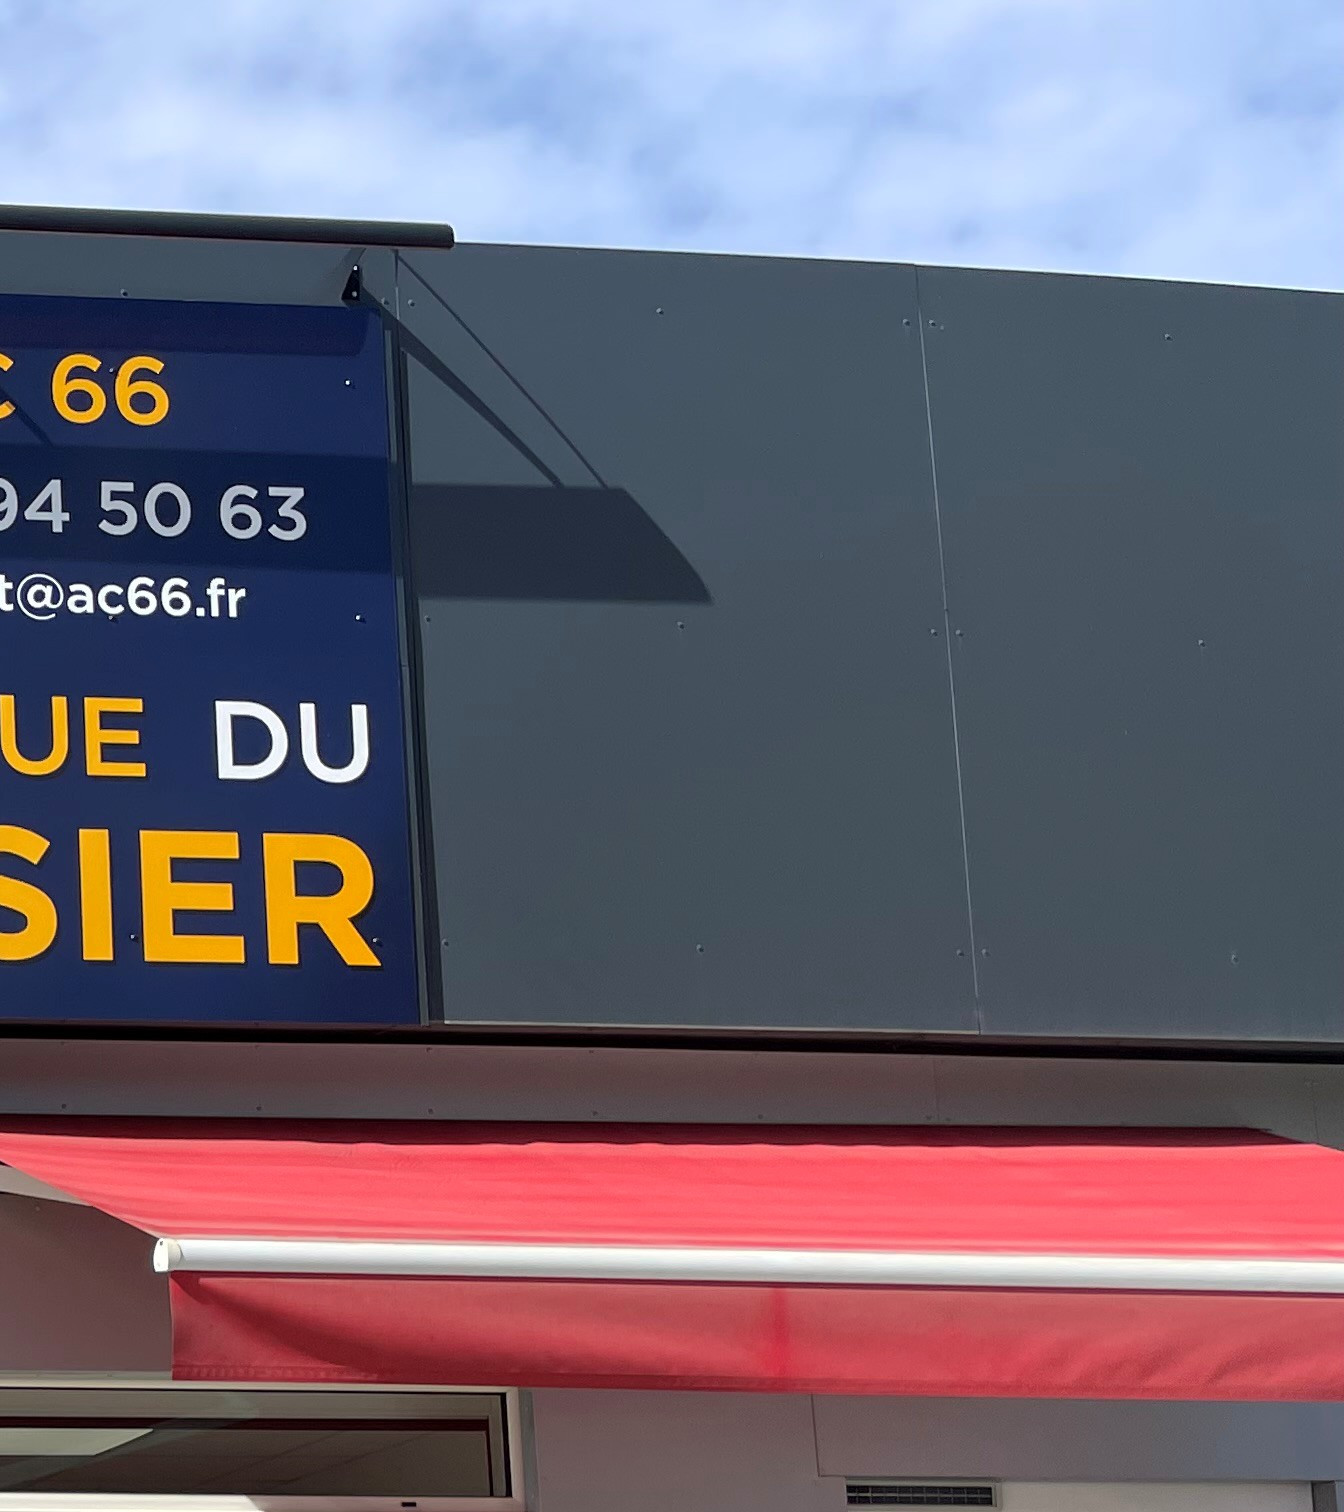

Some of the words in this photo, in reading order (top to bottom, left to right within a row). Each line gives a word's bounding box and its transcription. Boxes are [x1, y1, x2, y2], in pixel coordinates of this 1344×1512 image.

[52, 354, 169, 425] 66
[99, 481, 191, 536] 50
[220, 485, 306, 540] 63
[215, 701, 369, 783] DU
